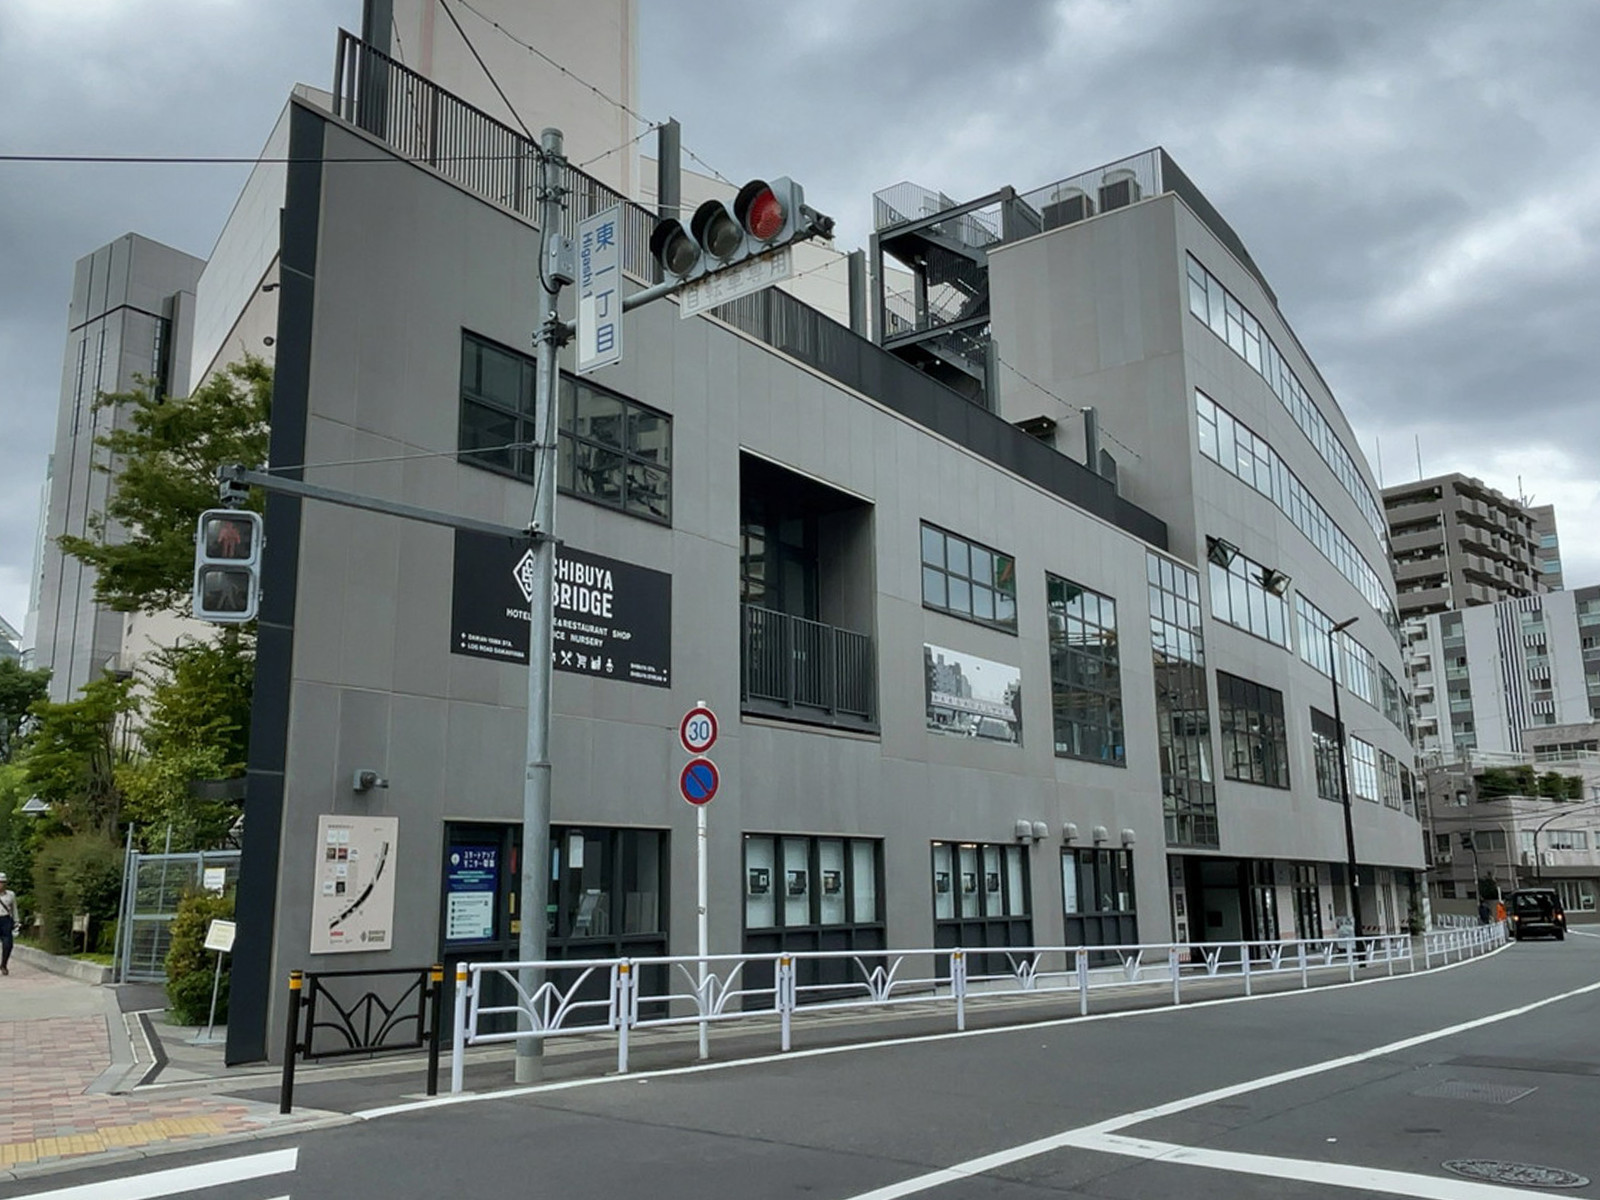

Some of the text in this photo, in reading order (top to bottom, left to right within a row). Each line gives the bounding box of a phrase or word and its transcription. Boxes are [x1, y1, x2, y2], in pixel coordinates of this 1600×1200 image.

[581, 231, 593, 288] Higashi
[595, 221, 615, 353] 東一丁目
[552, 581, 613, 618] BRIDGE
[506, 608, 532, 620] HOTEL
[612, 629, 632, 640] SHOP
[570, 634, 603, 647] NURSERY
[689, 720, 710, 741] 30
